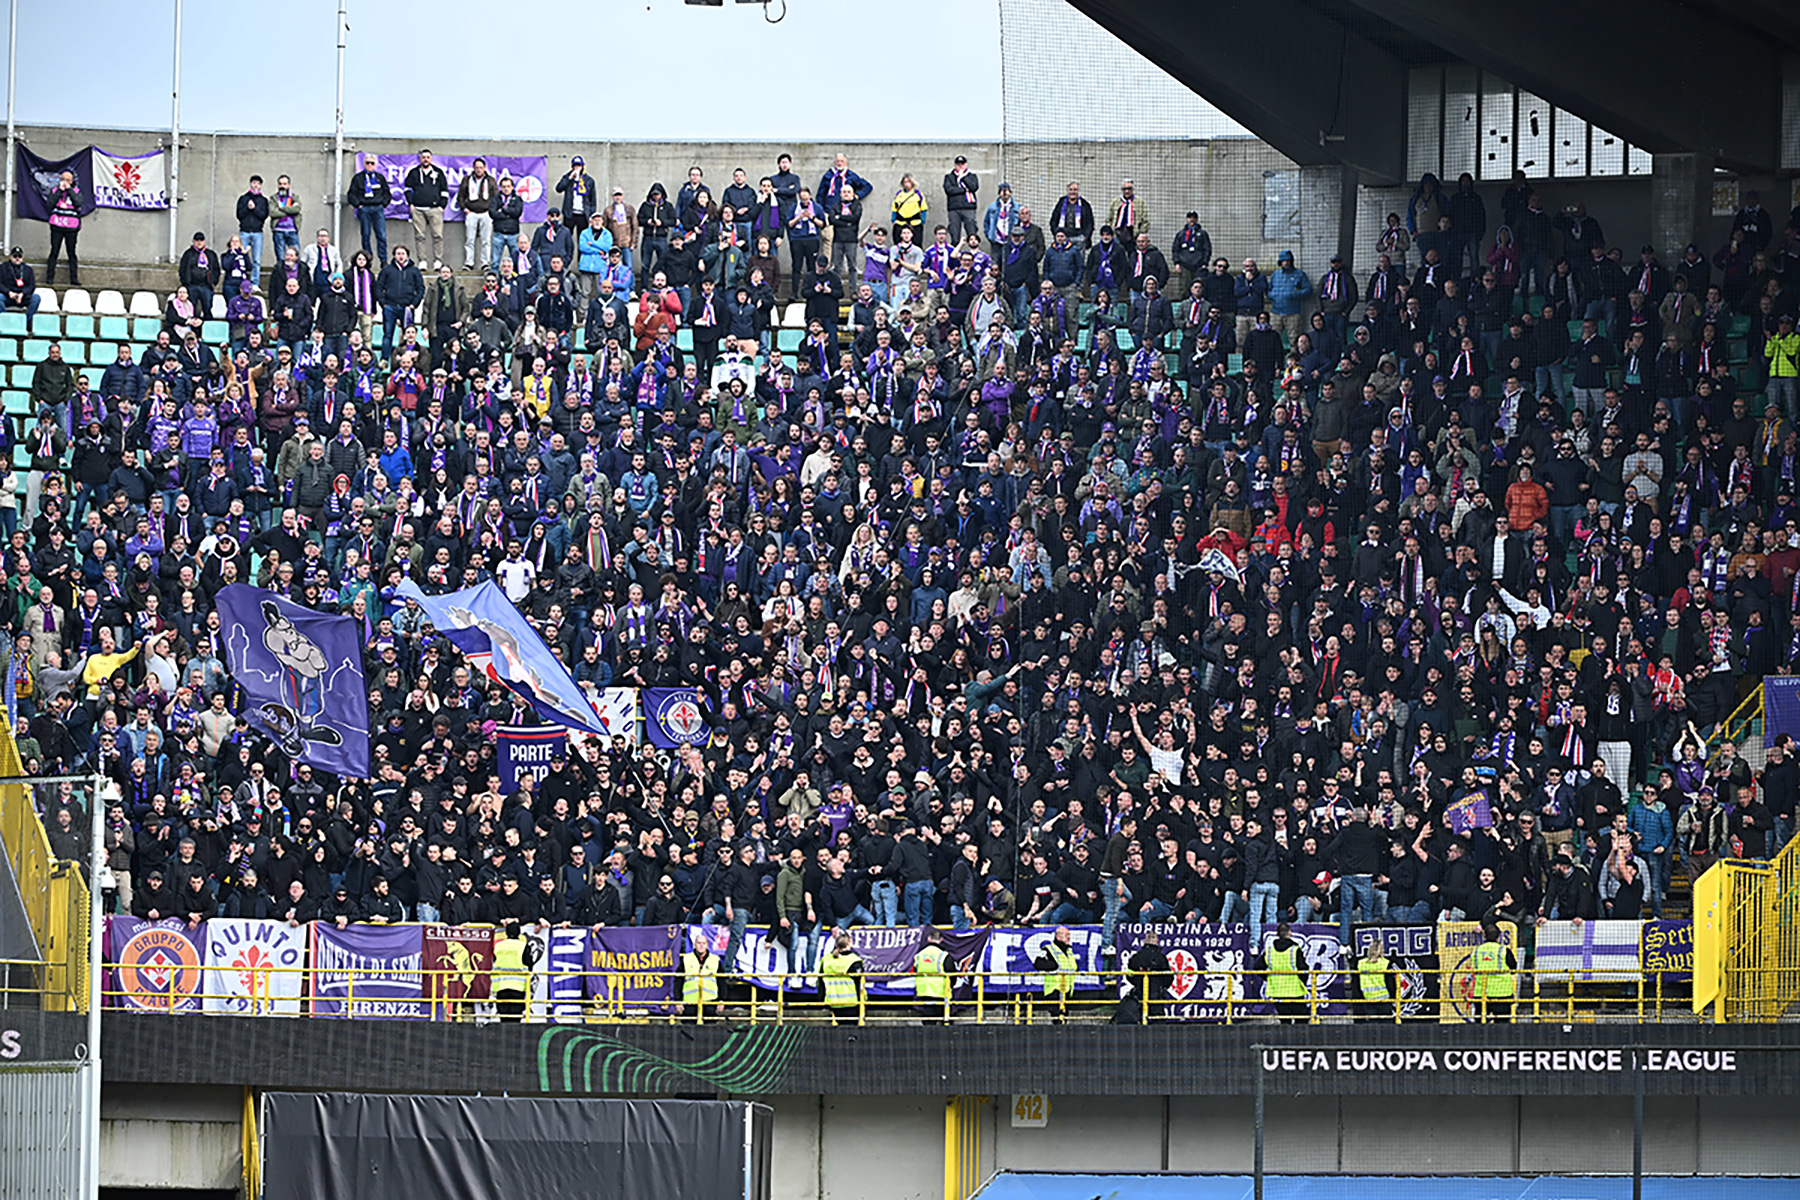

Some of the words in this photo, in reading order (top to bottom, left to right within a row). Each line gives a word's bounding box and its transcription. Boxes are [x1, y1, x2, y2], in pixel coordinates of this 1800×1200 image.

[510, 743, 553, 761] PARTE
[514, 765, 550, 783] ATA
[1119, 923, 1212, 935] FIORENTINA
[1217, 922, 1249, 935] A.C.
[133, 933, 185, 952] GRUPPO
[212, 922, 298, 966] QUINTO
[318, 934, 366, 982] QUELLI
[370, 958, 386, 980] DI
[591, 950, 674, 970] MARASMA
[339, 1001, 421, 1016] FIRENZE
[0, 1030, 21, 1059] S
[1262, 1050, 1330, 1071] UEFA
[1336, 1050, 1438, 1071] EUROPA
[1443, 1050, 1623, 1071] CONFERENCE
[1015, 1095, 1043, 1120] 412
